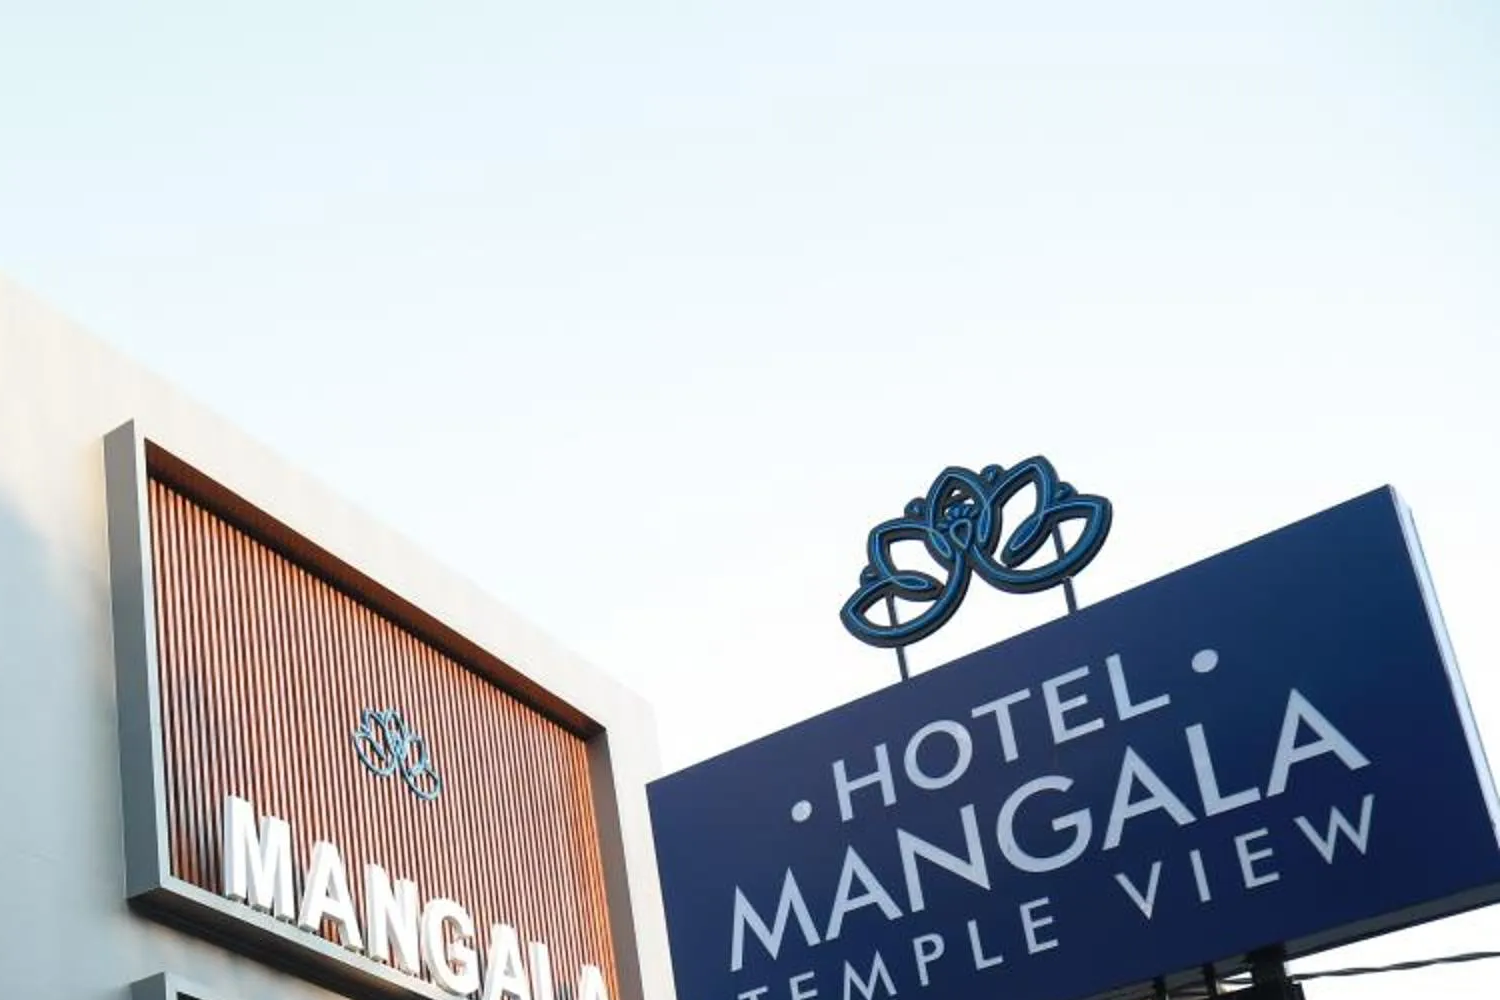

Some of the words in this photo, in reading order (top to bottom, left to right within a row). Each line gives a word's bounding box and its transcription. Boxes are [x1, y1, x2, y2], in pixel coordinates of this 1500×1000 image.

[833, 653, 1170, 822] HOTEL
[730, 688, 1370, 972] MANGALA
[1115, 794, 1374, 920] VIEW
